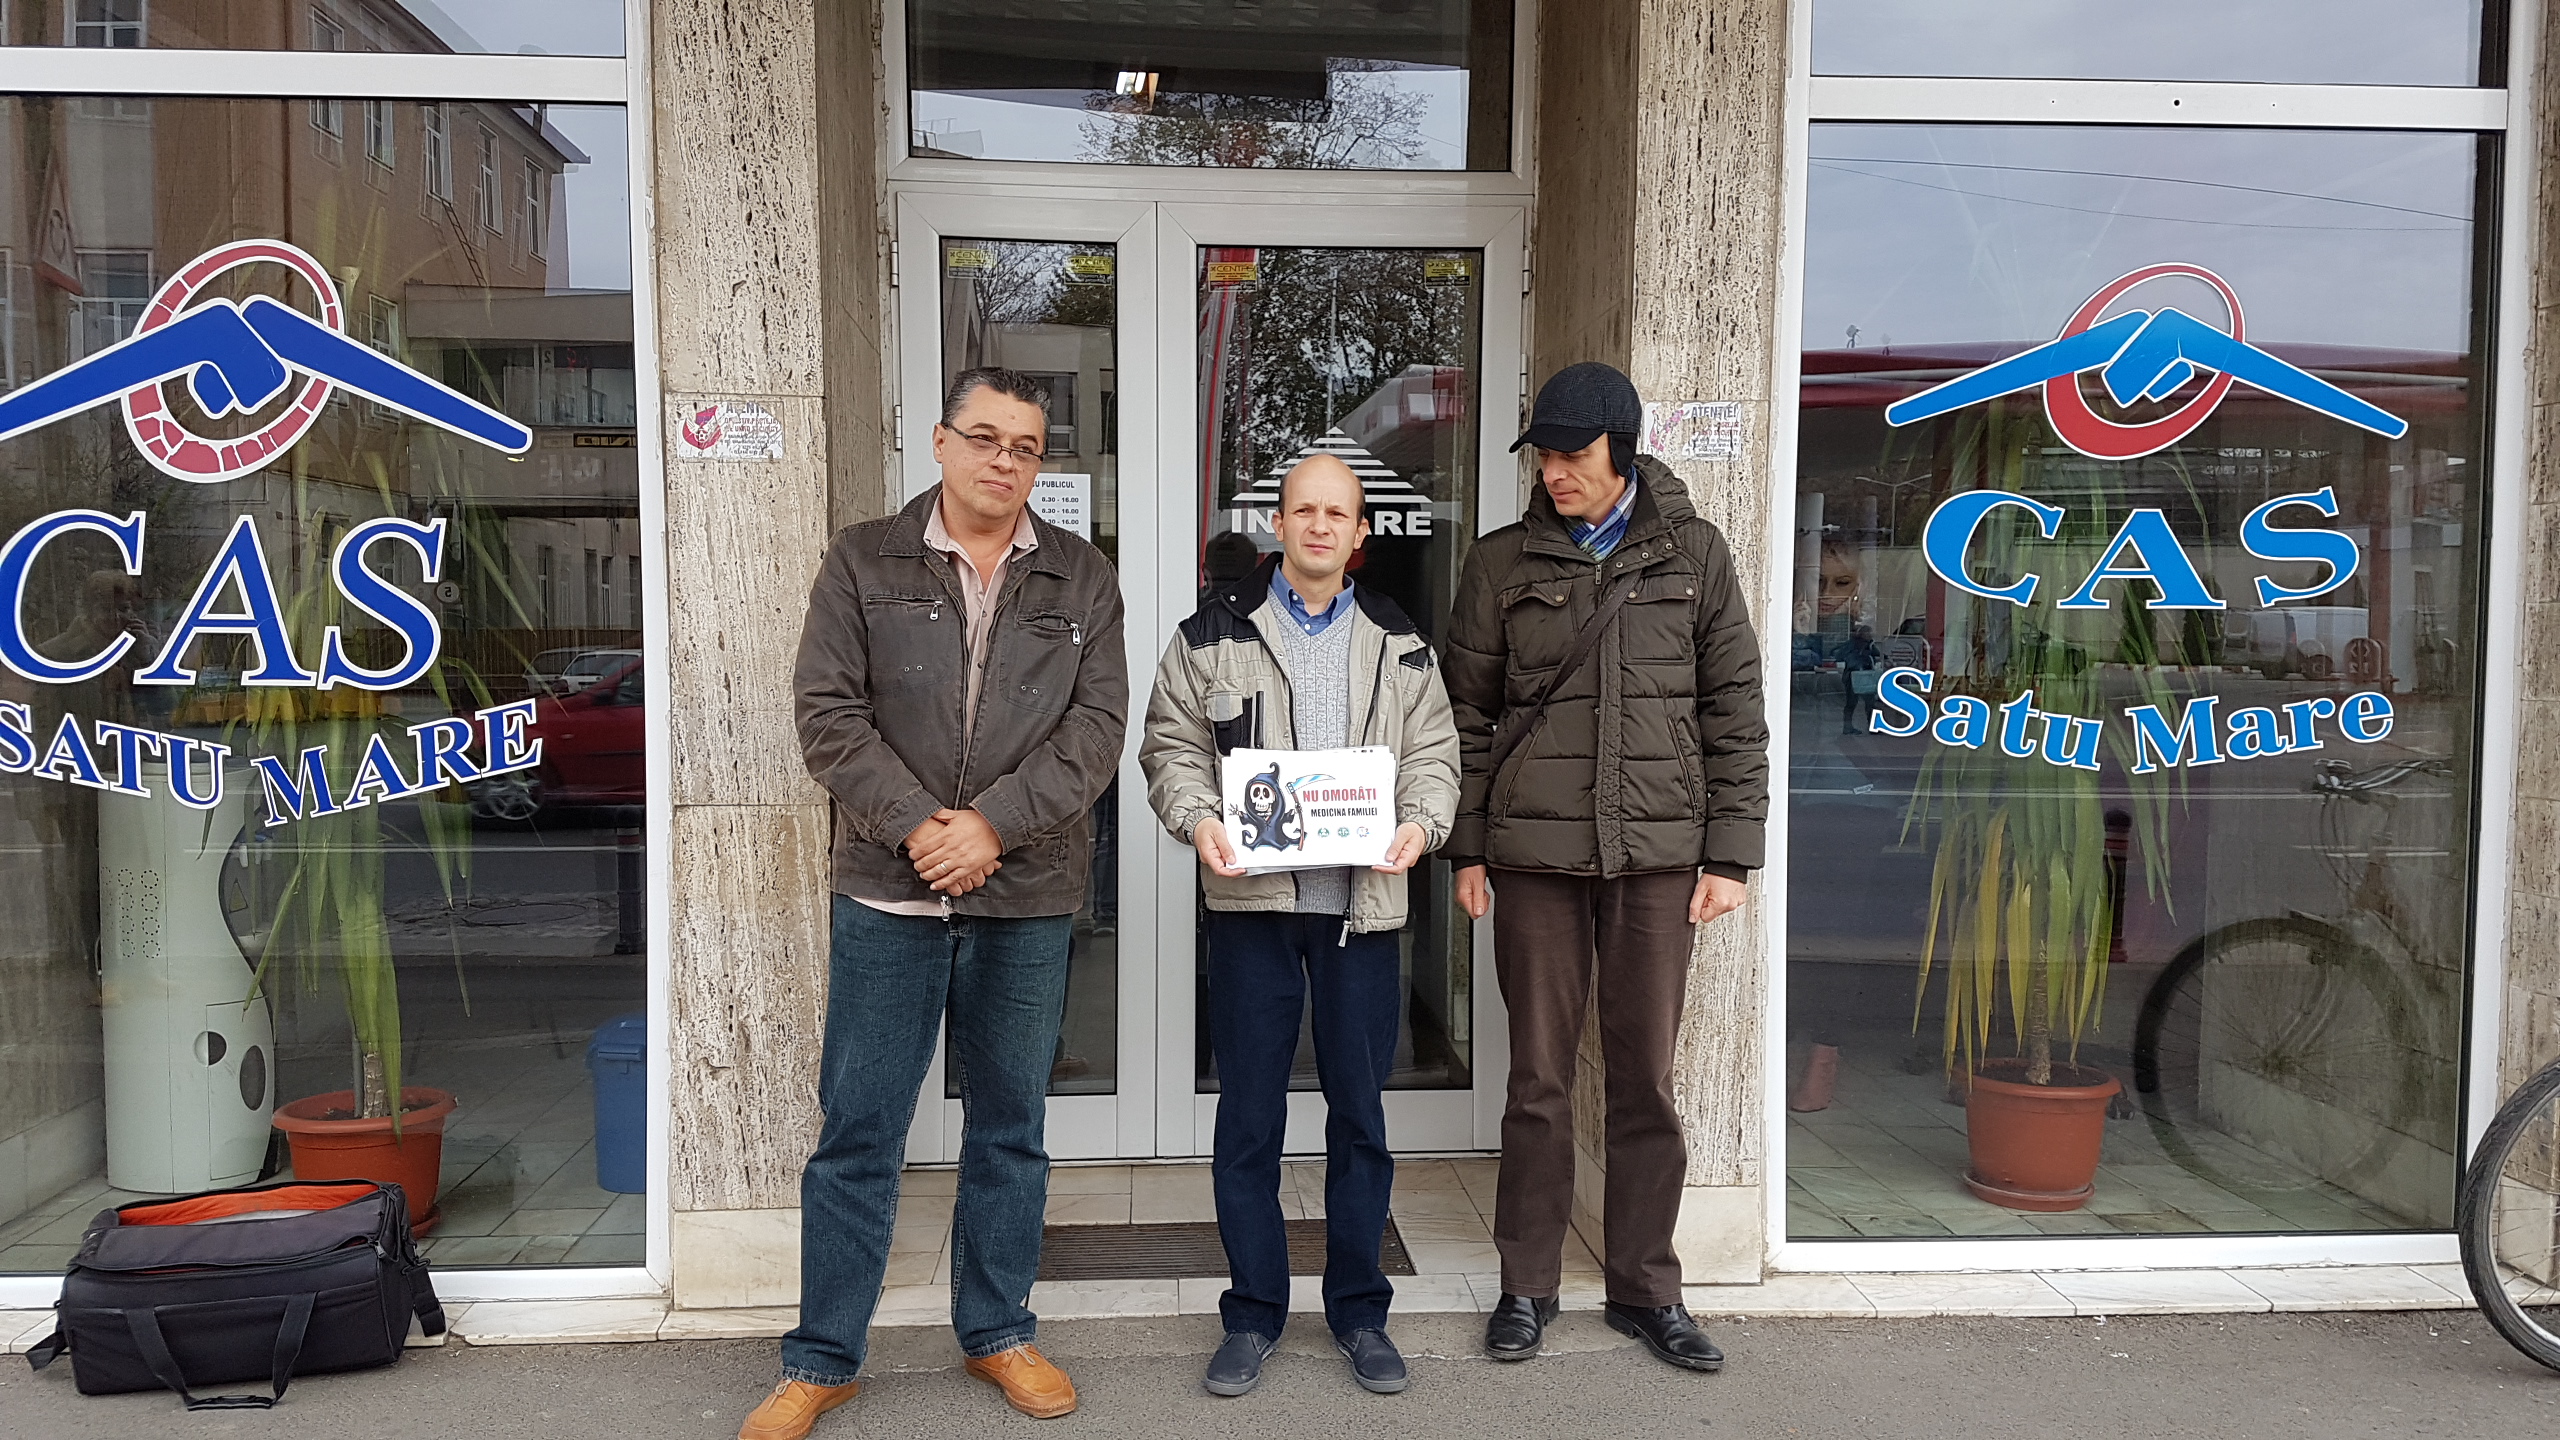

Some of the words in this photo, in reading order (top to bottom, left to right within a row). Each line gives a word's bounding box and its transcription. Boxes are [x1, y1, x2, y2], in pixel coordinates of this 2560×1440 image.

[1041, 480, 1075, 489] PUBLICUL
[0, 509, 446, 691] CAS
[1922, 486, 2361, 609] CAS
[0, 699, 231, 809] SATU
[251, 698, 542, 827] MARE
[1869, 669, 2103, 772] Satu
[2124, 690, 2395, 775] Mare
[1302, 789, 1319, 803] NU
[1311, 808, 1346, 817] MEDICINA
[1347, 807, 1378, 817] FAMILIEI
